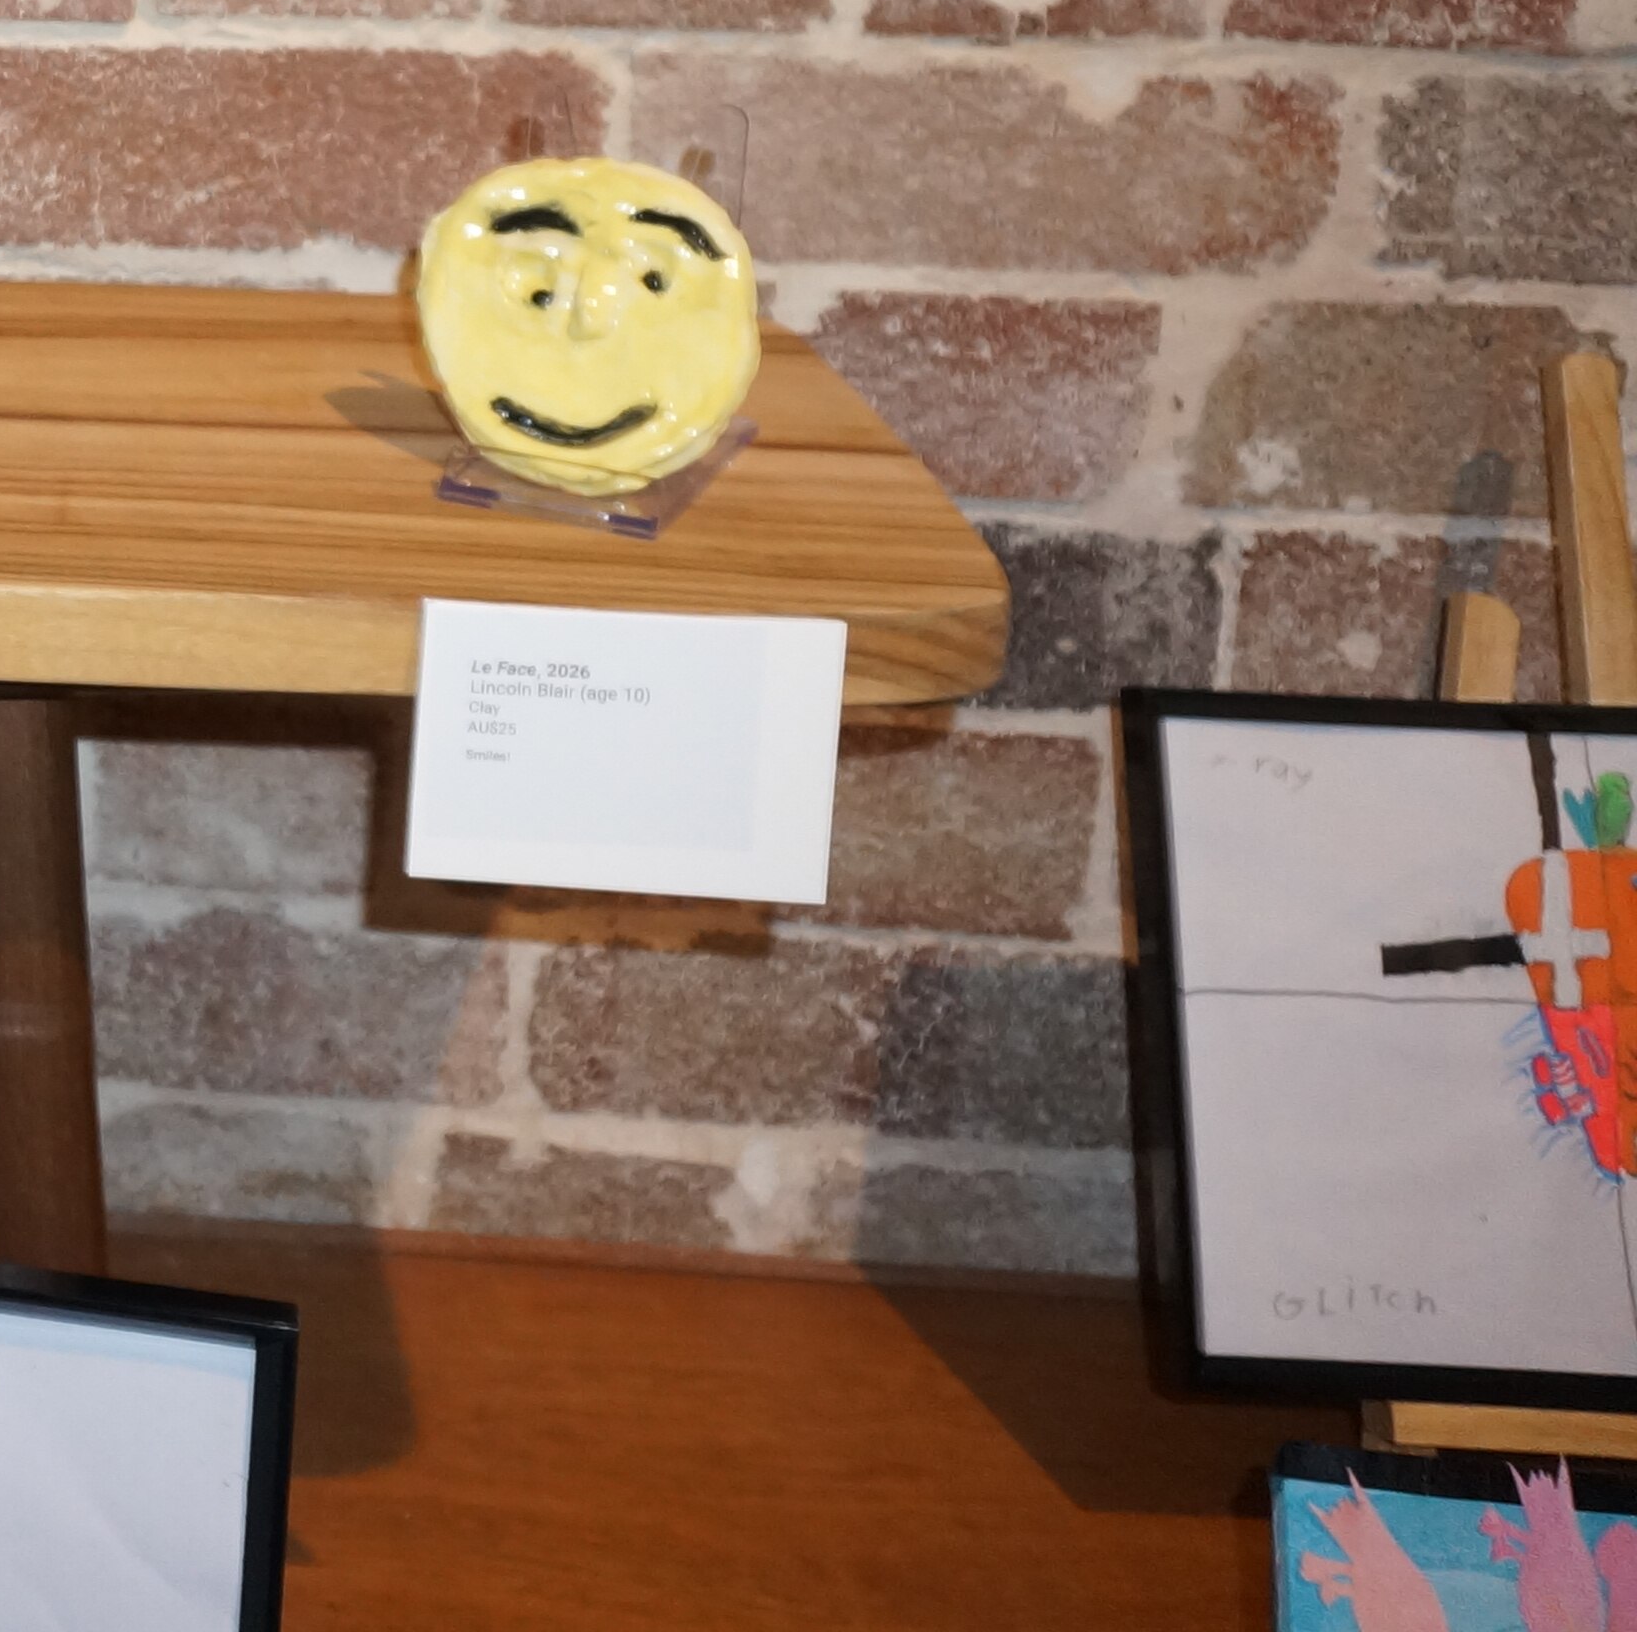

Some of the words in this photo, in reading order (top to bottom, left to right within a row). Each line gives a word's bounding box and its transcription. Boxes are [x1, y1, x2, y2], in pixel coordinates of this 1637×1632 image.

[470, 660, 493, 674] Le
[496, 661, 541, 680] Face,
[546, 663, 591, 679] 2026
[470, 679, 532, 697] Lincoln
[537, 683, 575, 699] Blair
[580, 684, 618, 704] (age
[624, 687, 651, 706] 10)
[468, 700, 501, 716] Clay
[467, 720, 517, 736] AU$25
[466, 749, 511, 762] Smiles!
